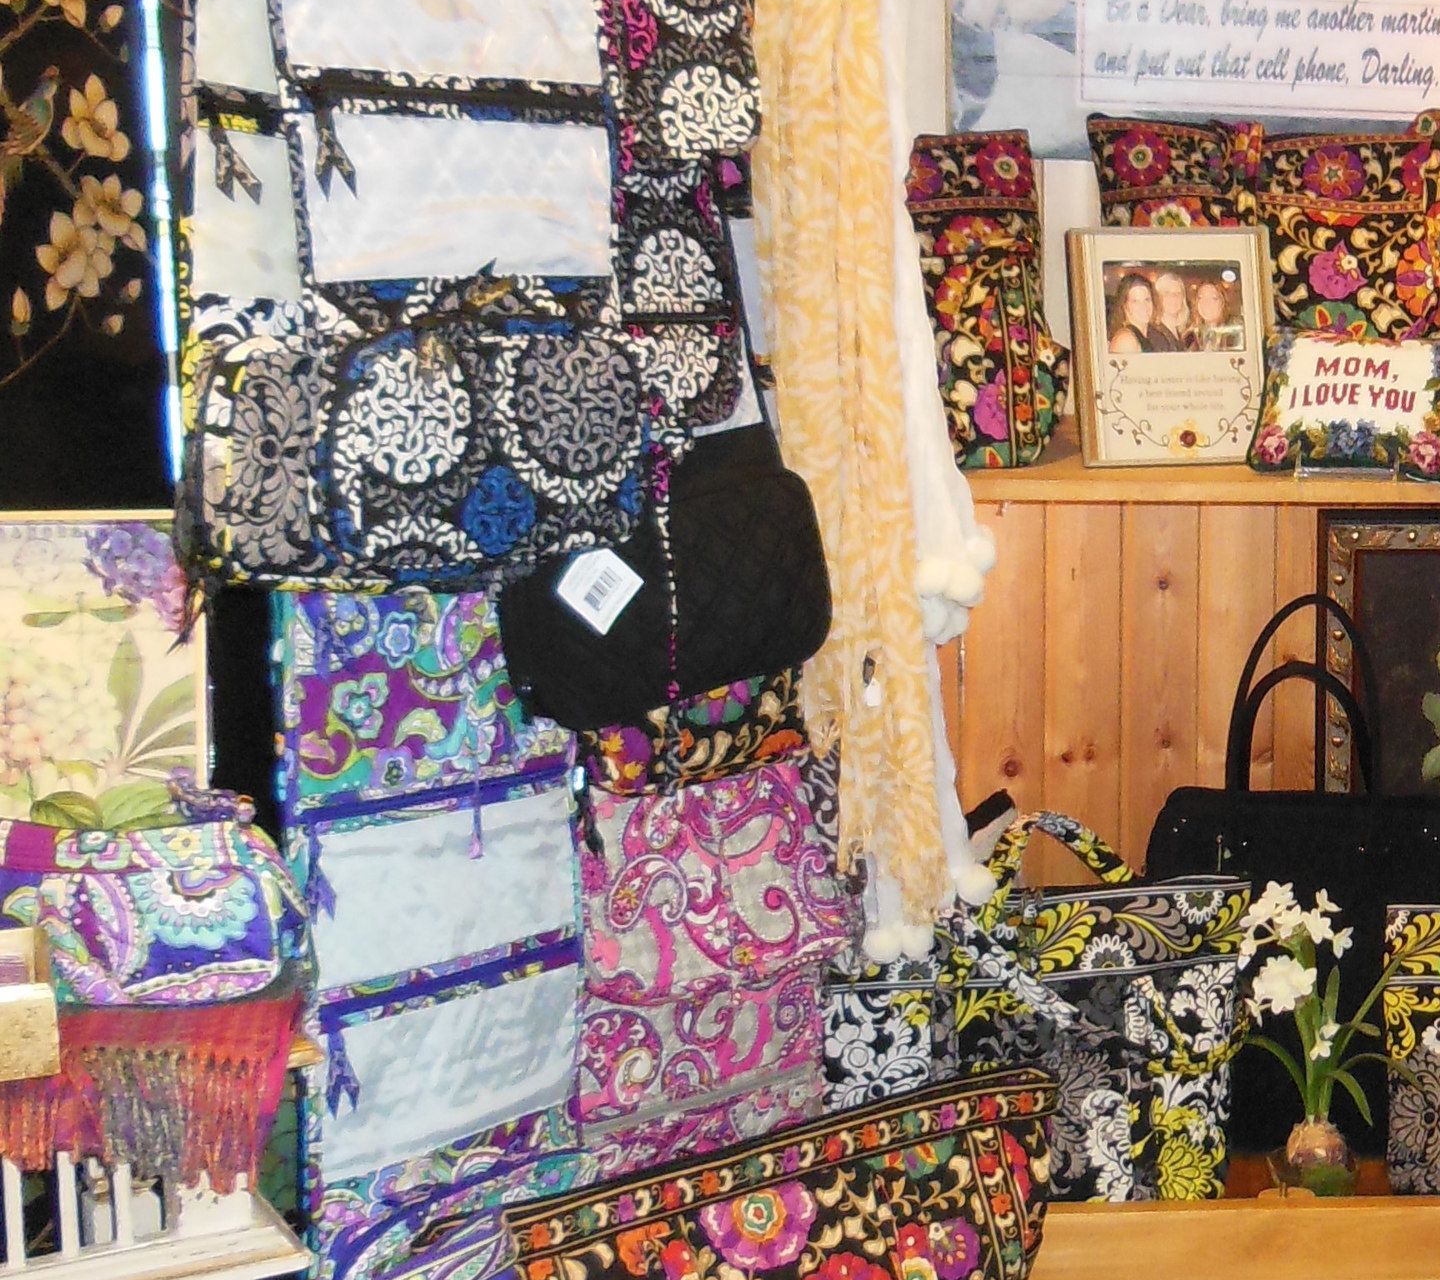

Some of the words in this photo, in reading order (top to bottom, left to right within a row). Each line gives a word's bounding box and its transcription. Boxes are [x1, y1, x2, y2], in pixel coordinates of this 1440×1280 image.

[1137, 1, 1149, 22] a
[1275, 8, 1301, 31] me
[1094, 43, 1132, 74] and
[1134, 48, 1171, 87] put
[1174, 50, 1206, 77] out
[1210, 43, 1251, 79] that
[1255, 47, 1290, 81] cell
[1291, 46, 1350, 93] phone,
[1315, 357, 1399, 383] MOM,
[1289, 387, 1298, 411] I
[1302, 383, 1362, 406] LOVE
[1368, 384, 1417, 413] YOU
